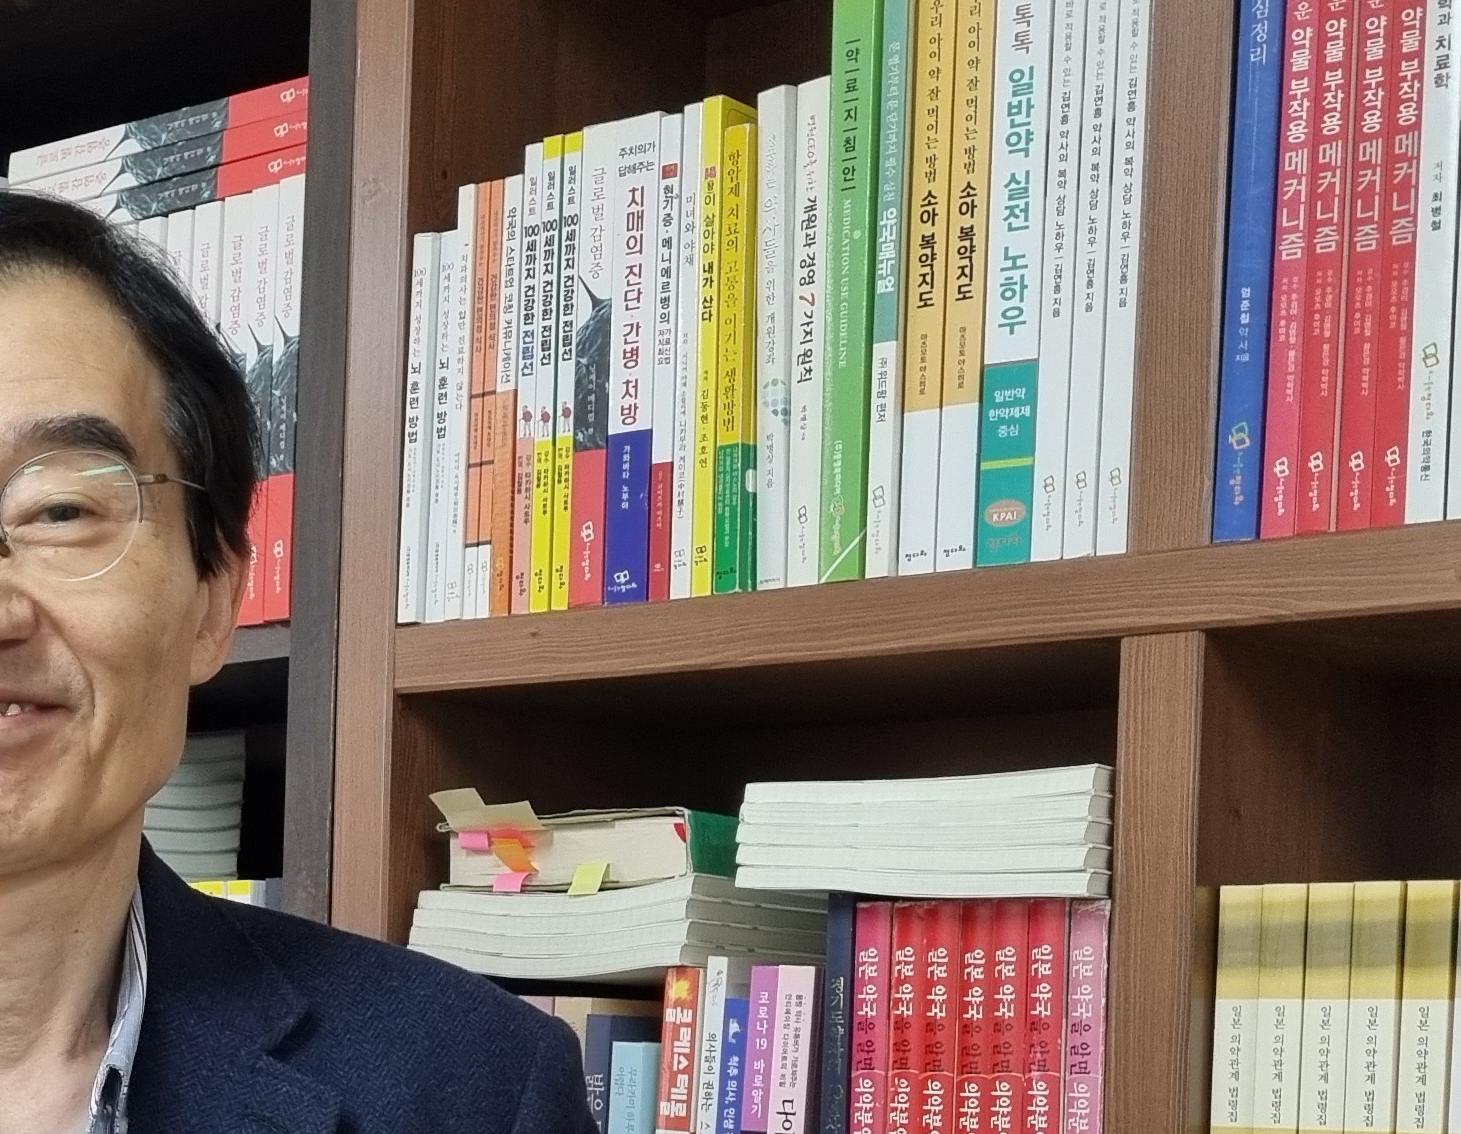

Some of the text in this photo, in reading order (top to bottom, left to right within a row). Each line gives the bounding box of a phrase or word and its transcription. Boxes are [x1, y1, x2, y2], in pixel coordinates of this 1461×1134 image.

[1290, 26, 1314, 73] 약물
[1400, 6, 1424, 53] 약물
[1286, 76, 1311, 144] 부작용
[1396, 57, 1421, 126] 부작용
[617, 141, 656, 178] 주치의가 답해주는
[997, 2, 1035, 336] 톡톡 일반약 실전 노하우
[1058, 129, 1070, 164] 약사의
[916, 32, 942, 310] 아이 약 잘 먹이는 방법 소아 복약지도
[1056, 168, 1068, 190] 복약
[1388, 130, 1420, 246] 메커니즘
[587, 166, 608, 280] 글로벌 감염증
[625, 186, 645, 256] 치매의
[1054, 194, 1067, 217] 상담
[1278, 147, 1308, 261] 메커니즘
[682, 192, 696, 266] 미녀와 야채
[876, 207, 898, 296] 약국매뉴얼
[1053, 219, 1066, 254] 노하우
[561, 164, 577, 362] 일러스트 건강한 전립선
[700, 212, 716, 324] 살아야 내가 산다
[838, 198, 853, 369] MEDICATION USE GUIDELINE
[500, 206, 517, 385] 약국의 스타트업 커뮤니케이션
[522, 284, 537, 326] 건강한
[721, 150, 741, 433] 항암제 치료의 고통을 이기는 생활방법
[765, 280, 776, 306] 위한
[796, 196, 818, 385] 개원과 경영 원칙
[1051, 297, 1063, 319] 지음
[409, 362, 423, 376] 뇌
[520, 329, 536, 377] 전립선
[408, 379, 422, 410] 훈련
[988, 406, 1031, 422] 한약제제
[993, 387, 1027, 403] 일반약
[406, 415, 420, 444] 방법
[997, 424, 1019, 438] 중심
[992, 510, 1017, 522] KPAI
[857, 946, 880, 981] 일본
[1072, 945, 1095, 982] 일본
[856, 983, 878, 1035] 약국을
[1070, 983, 1094, 1036] 약국을
[1231, 1005, 1243, 1030] 일본
[1417, 1005, 1431, 1032] 일본
[659, 1005, 693, 1119] 콜레스테롤
[702, 1031, 718, 1077] 의사들이
[726, 1055, 739, 1080] 척추
[750, 991, 770, 1119] 코로나 19 바로알기
[855, 1039, 876, 1073] 알면
[1069, 1041, 1092, 1076] 알면
[1228, 1033, 1242, 1083] 의약관계
[1415, 1035, 1429, 1087] 의약관계
[699, 1079, 716, 1113] 권하는
[723, 1107, 736, 1131] 인생
